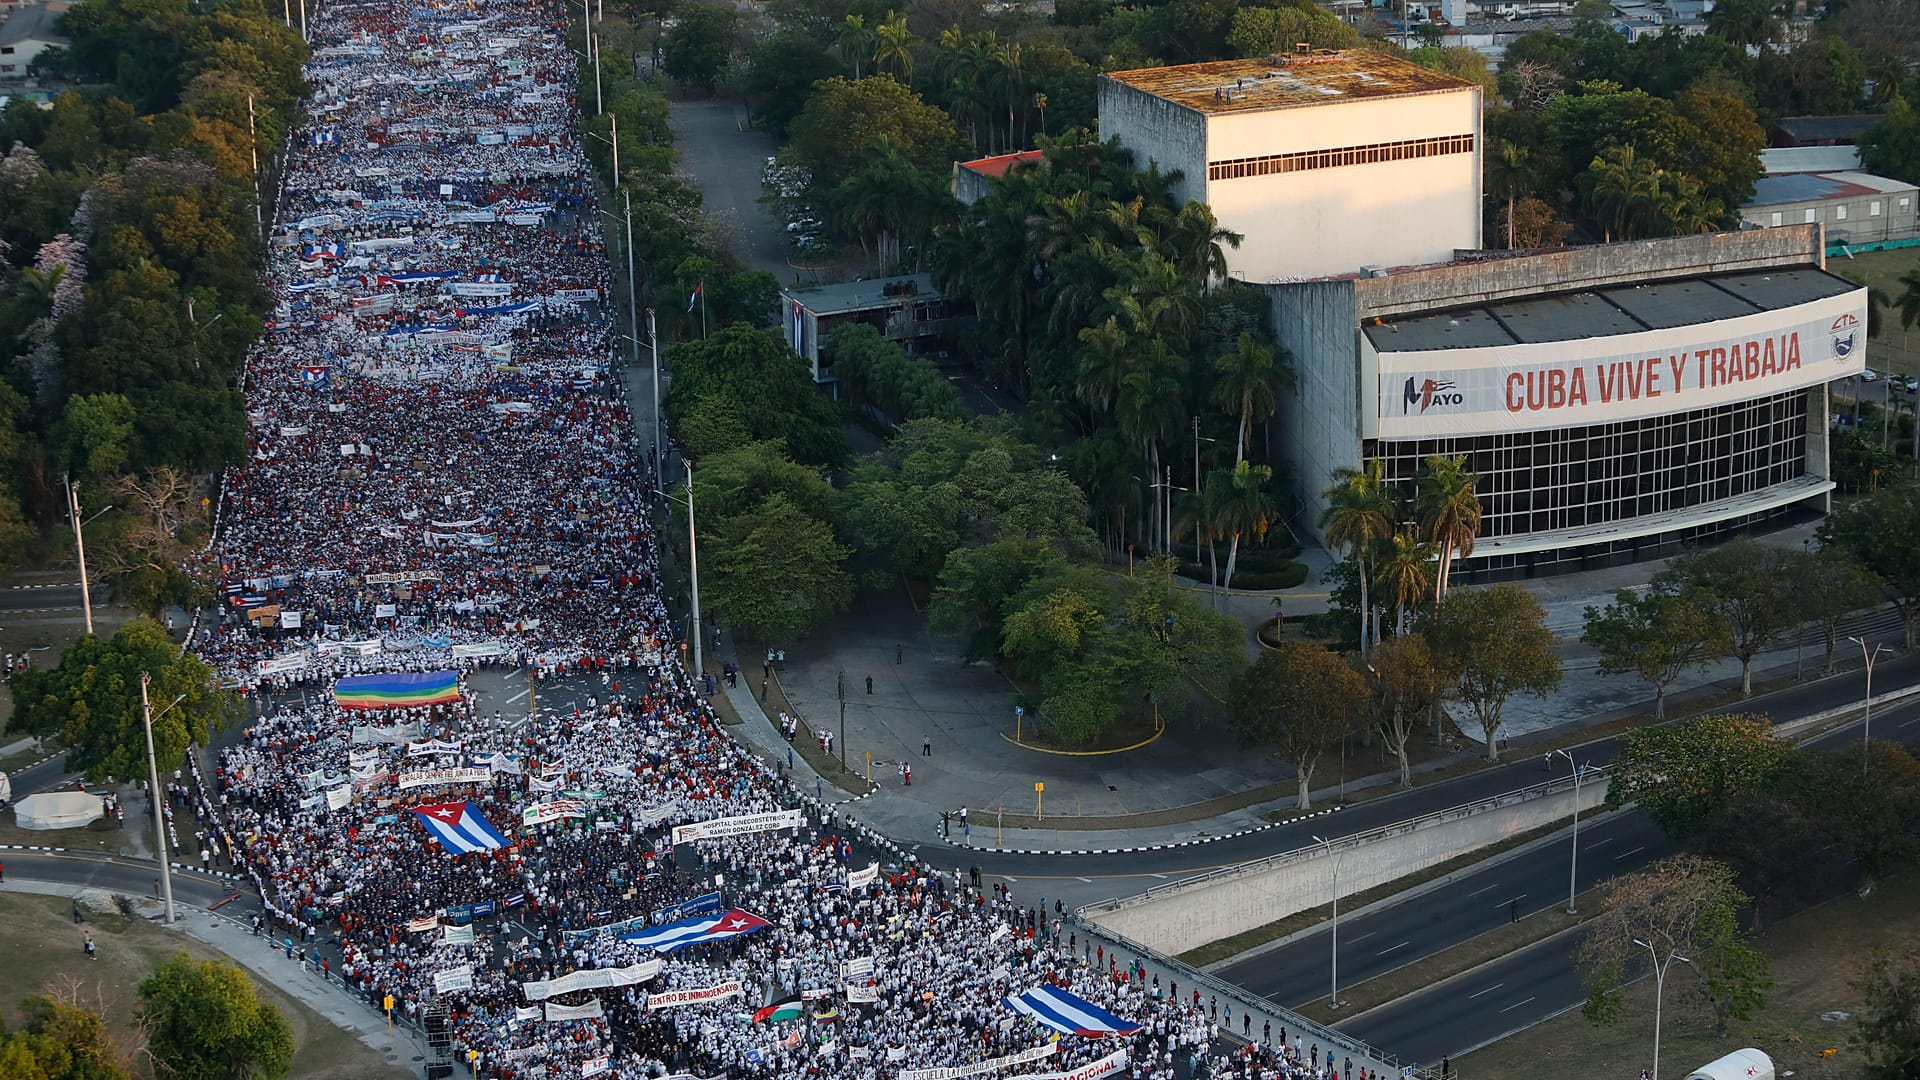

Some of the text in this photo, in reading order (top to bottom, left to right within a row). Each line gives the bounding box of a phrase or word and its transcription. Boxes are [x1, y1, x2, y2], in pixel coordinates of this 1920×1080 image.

[1505, 331, 1802, 413] CUBA VIVE Y TRABAJA
[703, 820, 732, 830] HOSPITAL
[649, 983, 739, 1006] CENTRO DE INMUNOENSAYO
[912, 1069, 945, 1080] ESCUELA
